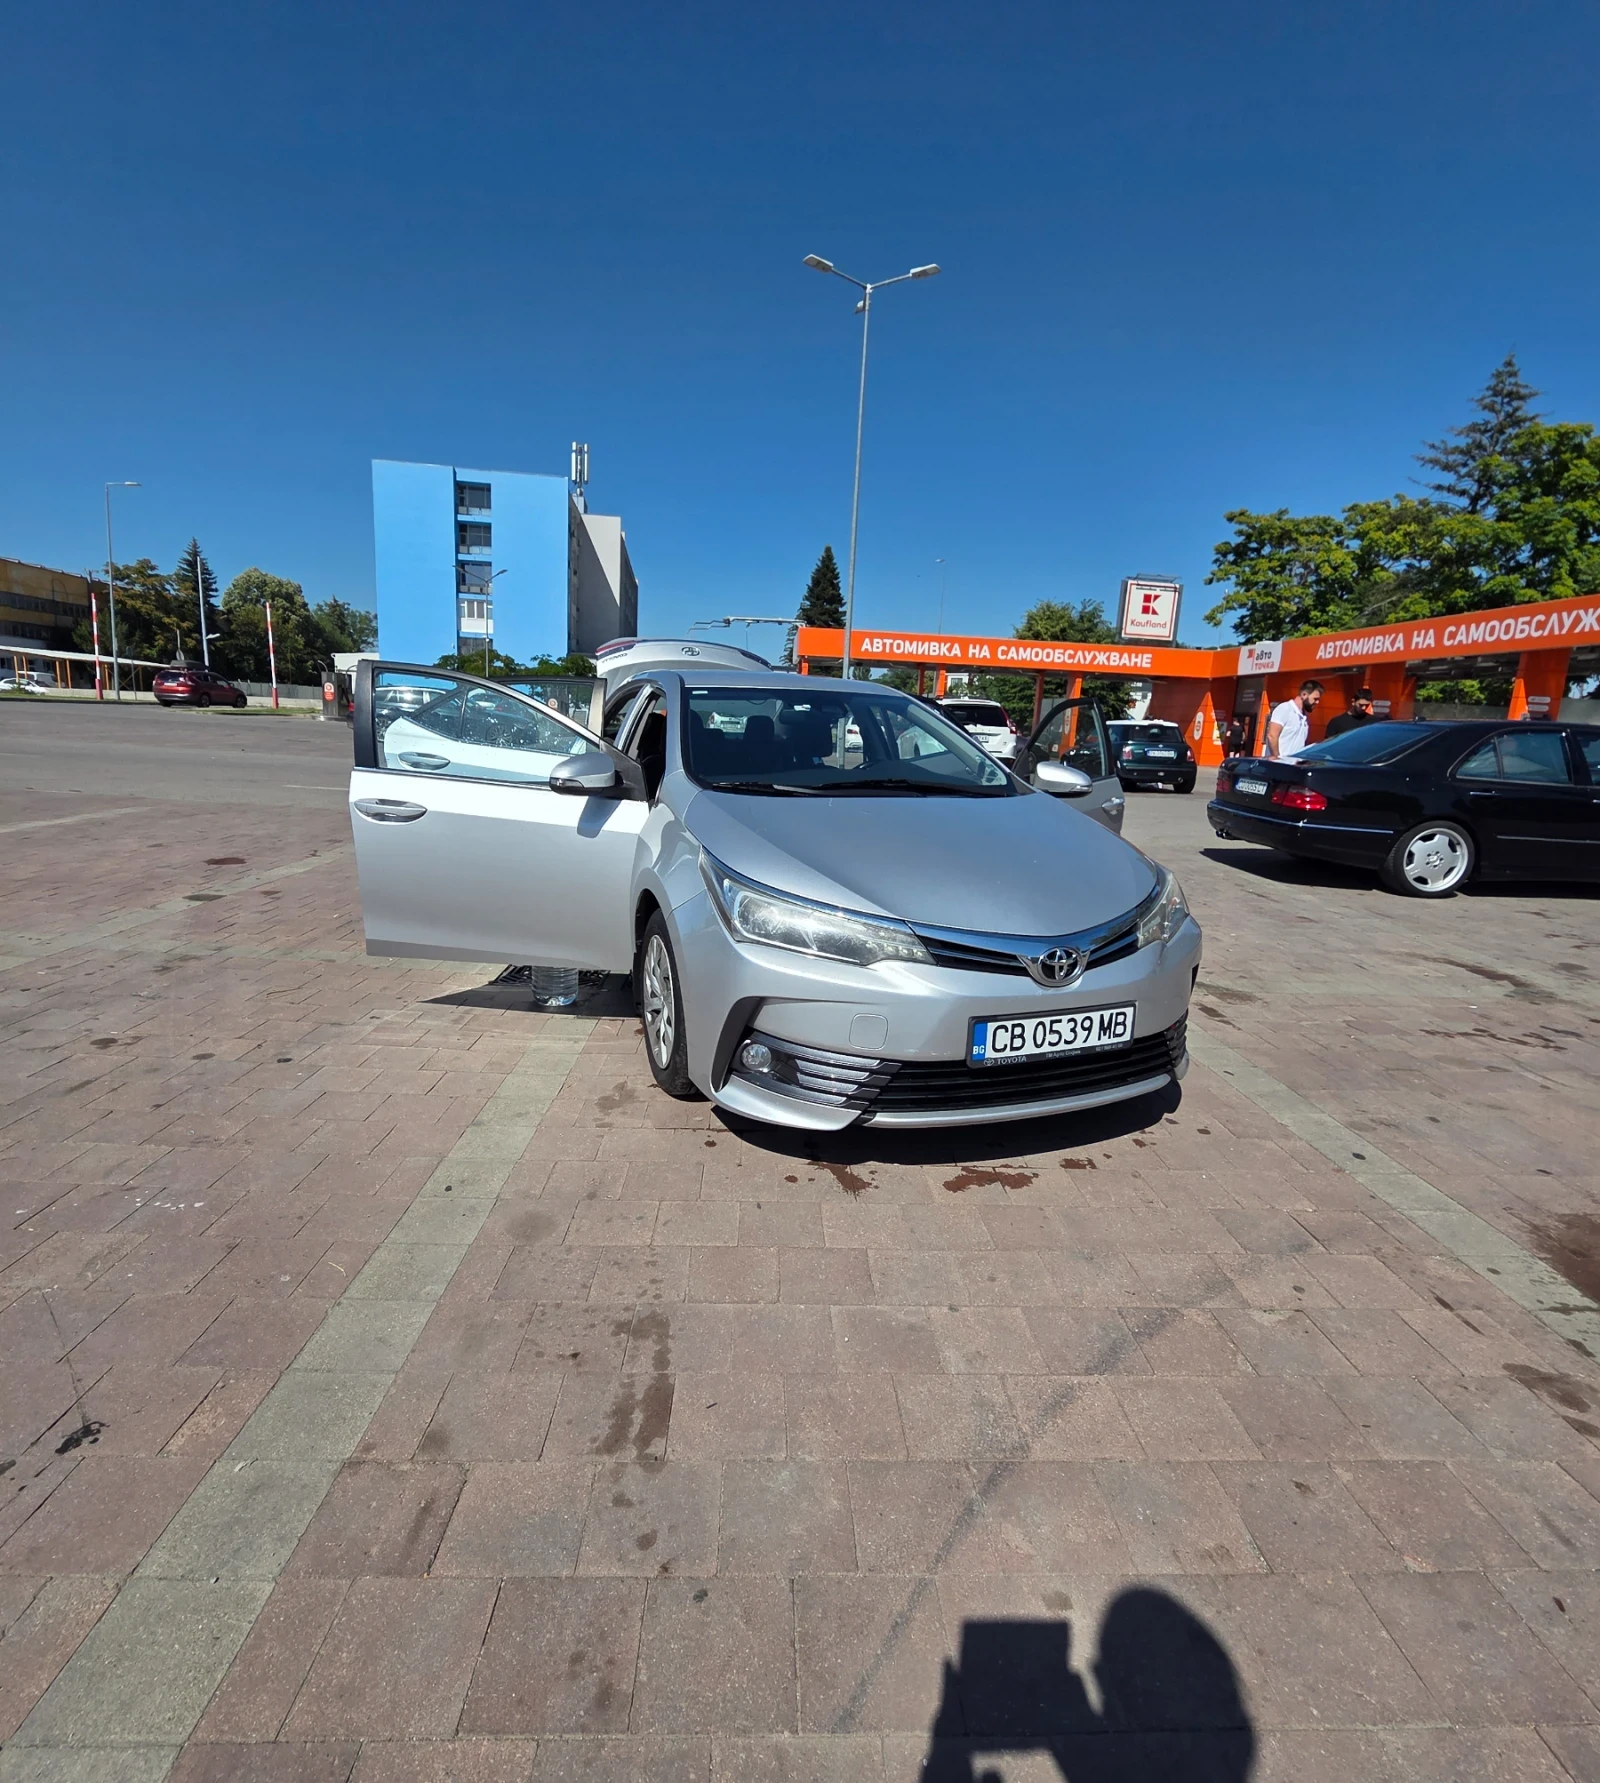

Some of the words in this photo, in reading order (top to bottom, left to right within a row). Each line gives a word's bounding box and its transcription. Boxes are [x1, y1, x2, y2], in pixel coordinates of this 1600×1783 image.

[1130, 618, 1168, 629] Kaufland
[1316, 632, 1404, 660] АВТОМИВКА
[1411, 628, 1435, 650] НА
[1443, 607, 1600, 647] САМООБСЛУЖ
[860, 637, 961, 658] АВТОМИВКА
[968, 643, 991, 659] НА
[997, 645, 1153, 668] САМООБСЛУЖВАНЕ
[1255, 650, 1272, 661] авто
[1254, 661, 1275, 671] точка
[991, 1022, 1026, 1053] CB
[1032, 1015, 1094, 1049] 0539
[1097, 1011, 1128, 1042] MB
[972, 1045, 985, 1055] BG
[997, 1055, 1027, 1065] TOYOTA
